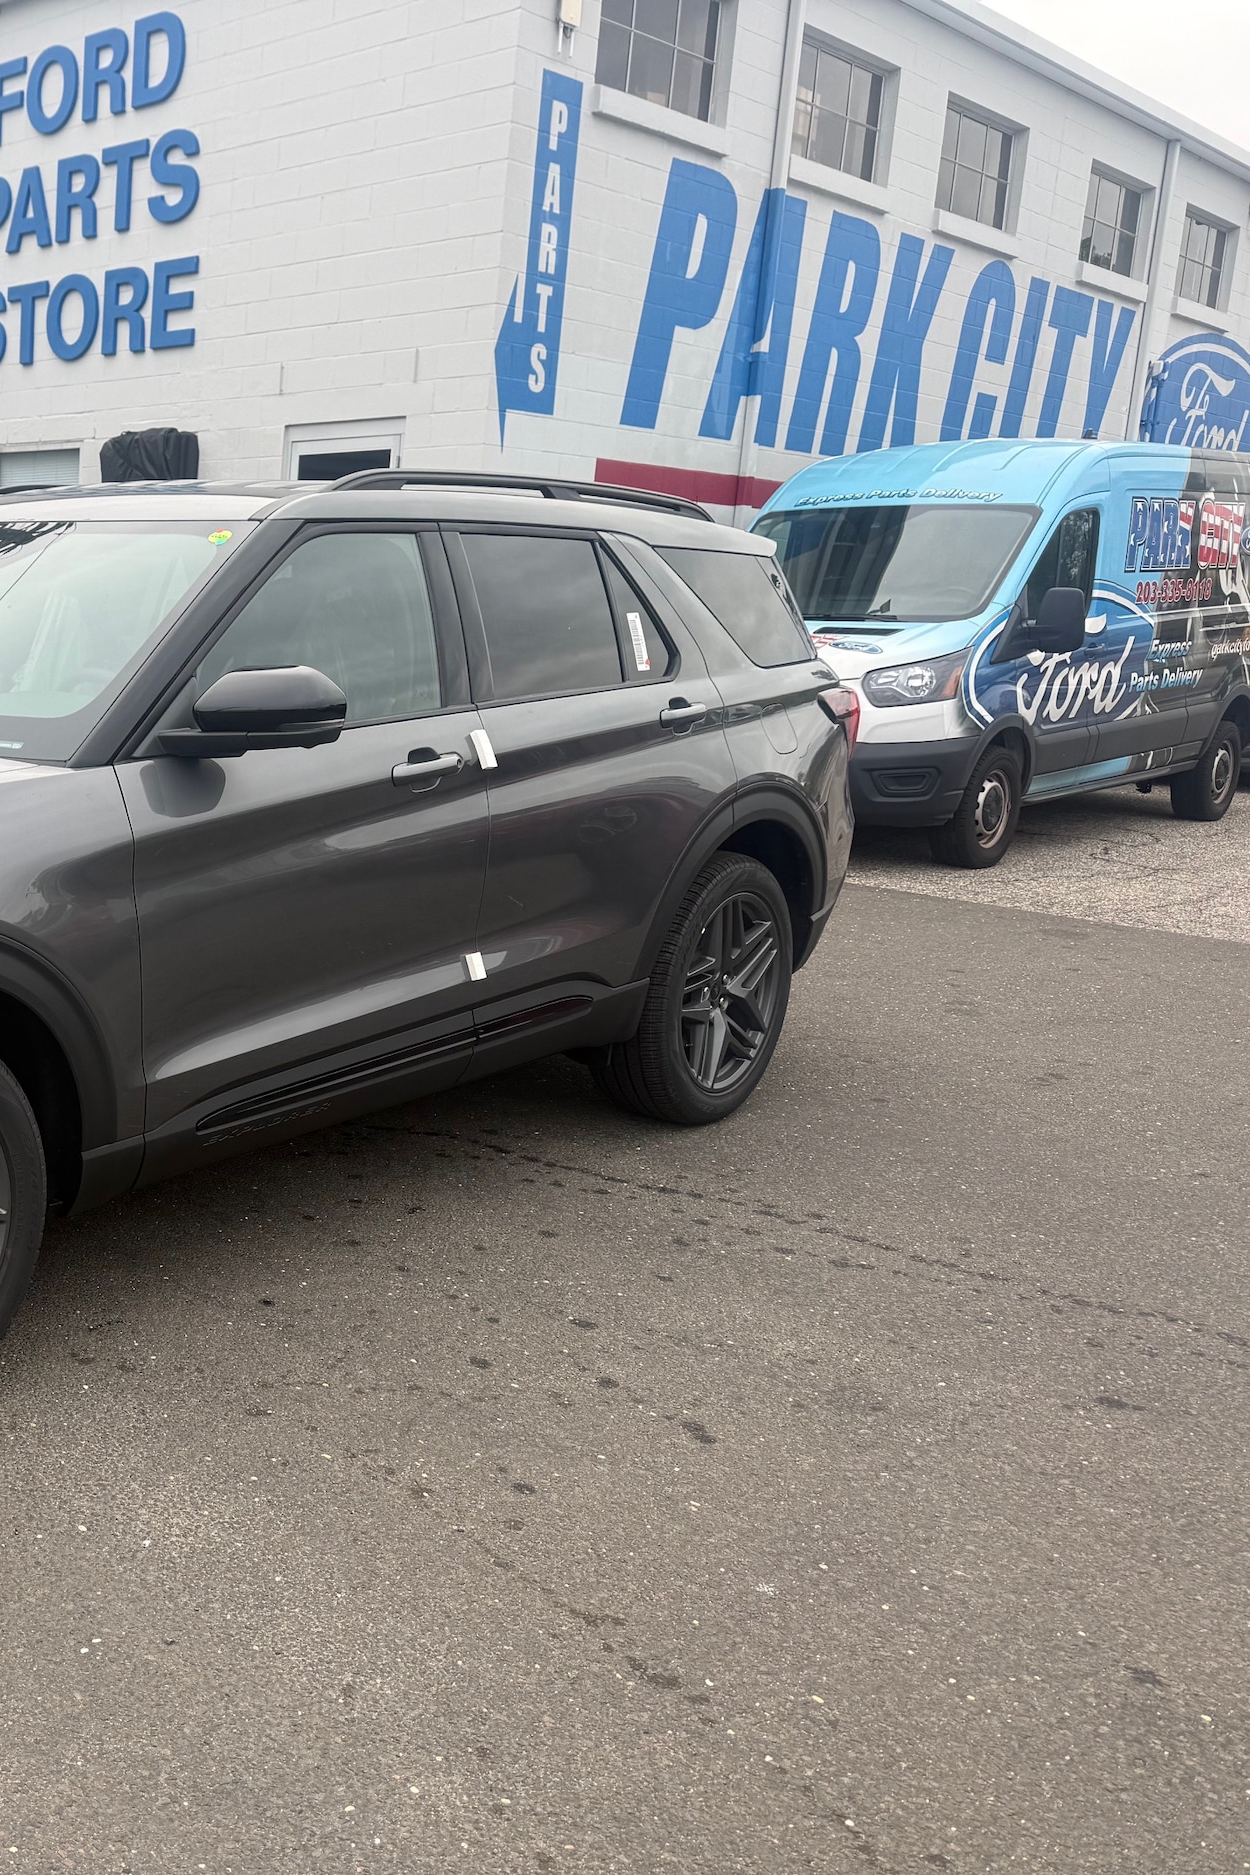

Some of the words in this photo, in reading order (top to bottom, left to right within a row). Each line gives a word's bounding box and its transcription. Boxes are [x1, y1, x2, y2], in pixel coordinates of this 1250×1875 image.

[528, 99, 568, 394] PARTS
[619, 157, 956, 455] PARK
[940, 259, 1137, 441] CITY
[794, 491, 865, 507] Express
[865, 488, 918, 500] Parts
[919, 488, 1003, 502] Delivery
[1124, 496, 1196, 573] PARK
[1197, 498, 1246, 570] CITY
[1135, 578, 1213, 605] 203-335-8118
[1016, 613, 1136, 727] Ford
[1148, 639, 1193, 661] Express
[1129, 671, 1159, 692] Parts
[1160, 666, 1204, 688] Delivery
